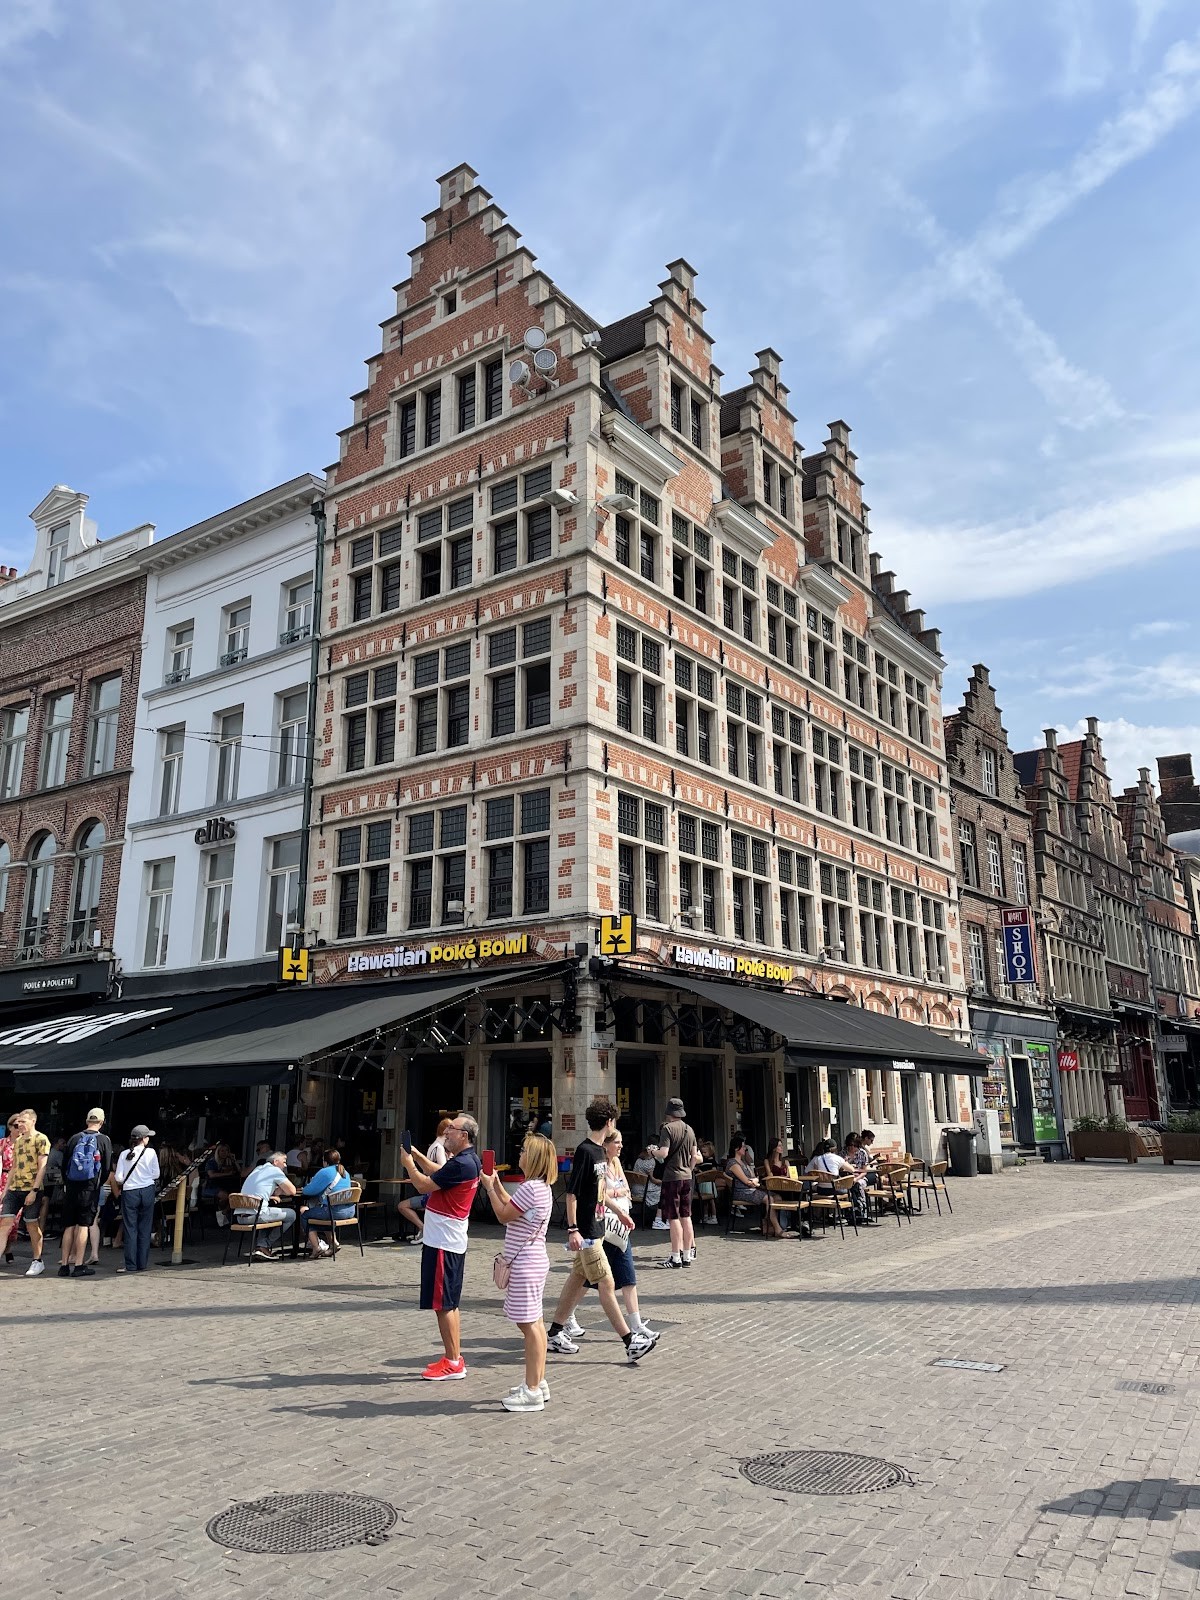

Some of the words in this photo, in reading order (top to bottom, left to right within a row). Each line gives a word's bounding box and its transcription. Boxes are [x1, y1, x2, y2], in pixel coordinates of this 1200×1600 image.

[195, 817, 235, 845] ellis
[347, 945, 427, 972] Hawaiian
[675, 945, 735, 972] Hawaiian
[1012, 928, 1026, 980] SHOP
[23, 981, 41, 990] POULE
[47, 977, 74, 987] POULETTE
[1158, 1035, 1185, 1043] CLUB
[1060, 1055, 1077, 1069] illy
[121, 1073, 160, 1088] Hawaiian
